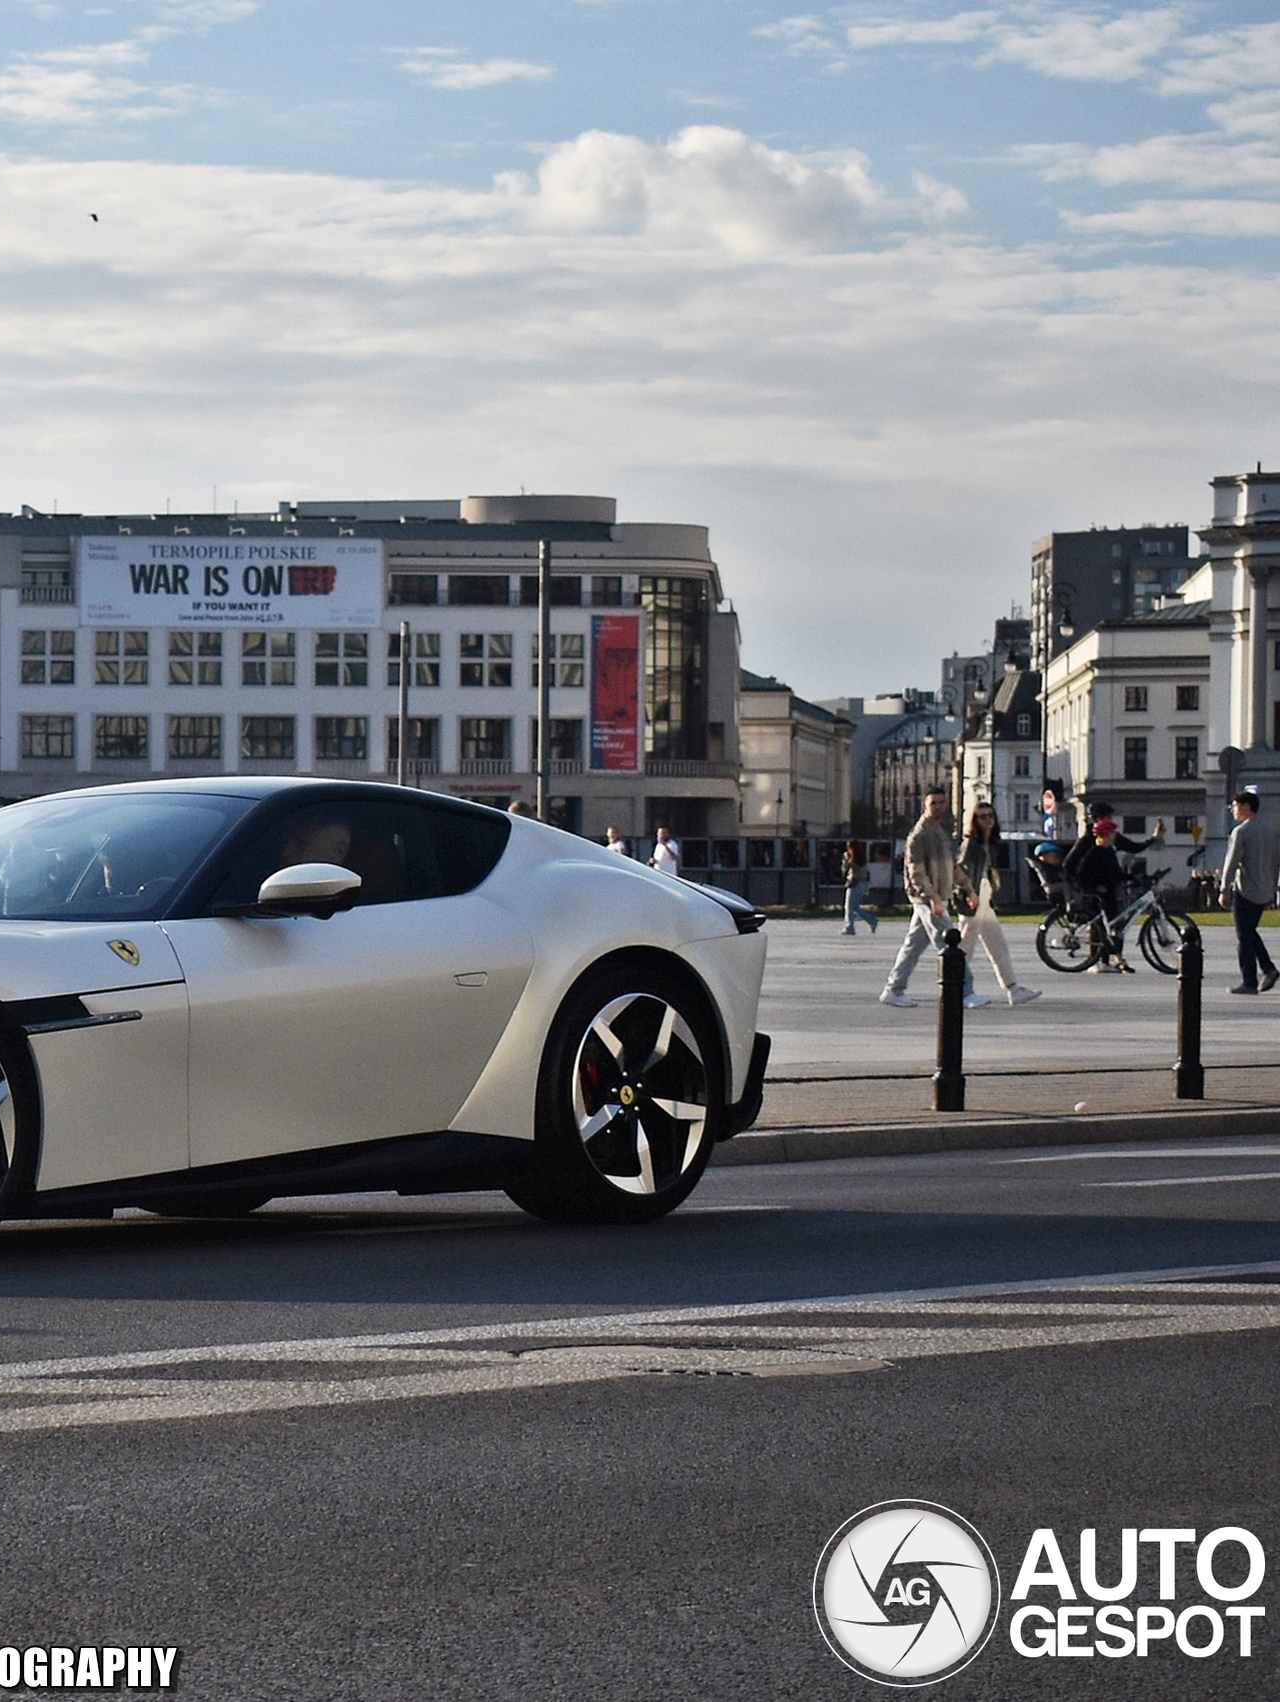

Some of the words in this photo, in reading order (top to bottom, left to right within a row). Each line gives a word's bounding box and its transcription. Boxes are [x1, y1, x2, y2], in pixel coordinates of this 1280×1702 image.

[148, 544, 244, 560] TERMOPILE
[248, 546, 317, 560] POLSKIE
[129, 564, 190, 595] WAR
[204, 565, 230, 597] IS
[192, 602, 202, 611] IF
[204, 602, 226, 611] YOU
[227, 602, 259, 611] WANT
[260, 602, 271, 611] IT
